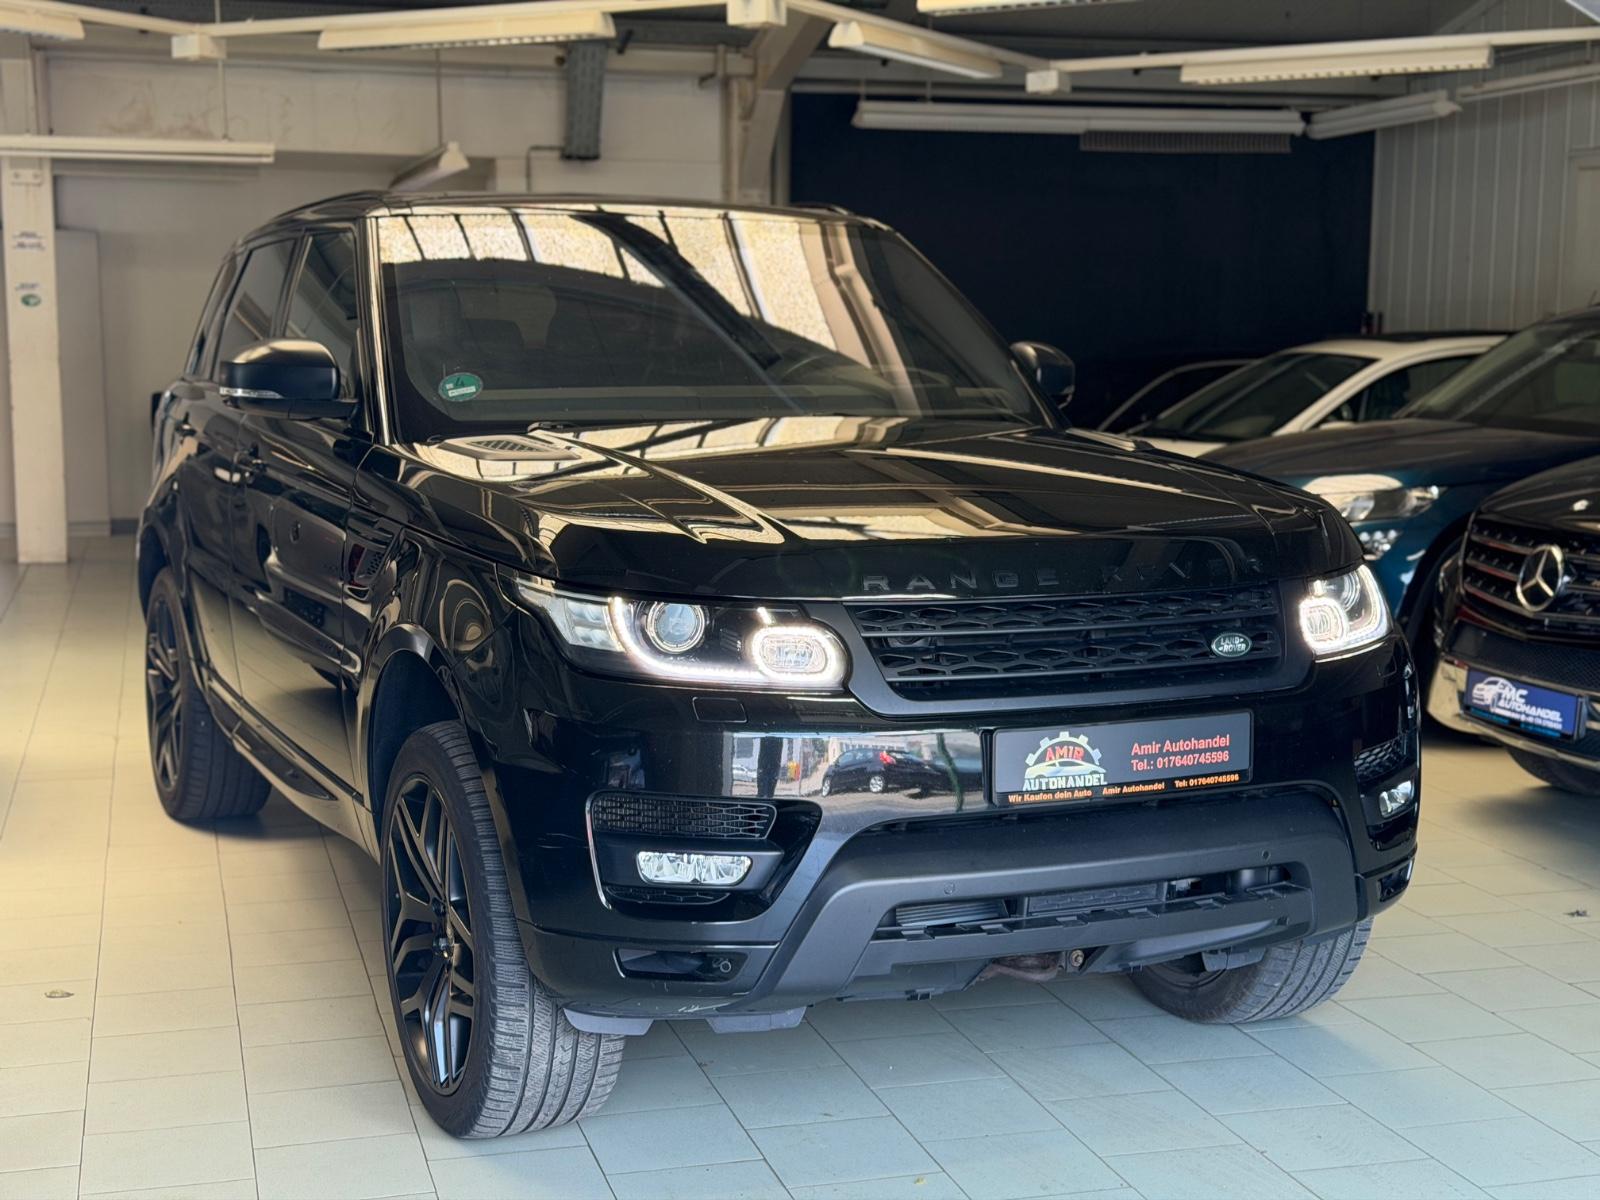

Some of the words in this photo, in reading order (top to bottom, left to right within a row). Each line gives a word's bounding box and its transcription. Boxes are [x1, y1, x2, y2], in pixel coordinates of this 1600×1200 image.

[862, 567, 1060, 591] RANGE
[1220, 636, 1240, 646] LAND
[1223, 643, 1247, 652] ROVER
[1045, 745, 1085, 762] AMIR
[1131, 741, 1161, 756] Amir
[1163, 733, 1230, 753] Autohandel
[1131, 758, 1154, 772] Tel.:
[1156, 750, 1230, 769] 017640745596
[1008, 793, 1023, 803] Wir
[1024, 790, 1053, 802] Kaufen
[1054, 789, 1072, 800] dein
[1073, 787, 1093, 798] Auto
[1102, 785, 1121, 795] Amir
[1122, 781, 1165, 793] Autohandel
[1174, 779, 1188, 788] Tel:
[1189, 773, 1240, 787] 017640745596
[1022, 773, 1108, 791] AUTOHANDEL
